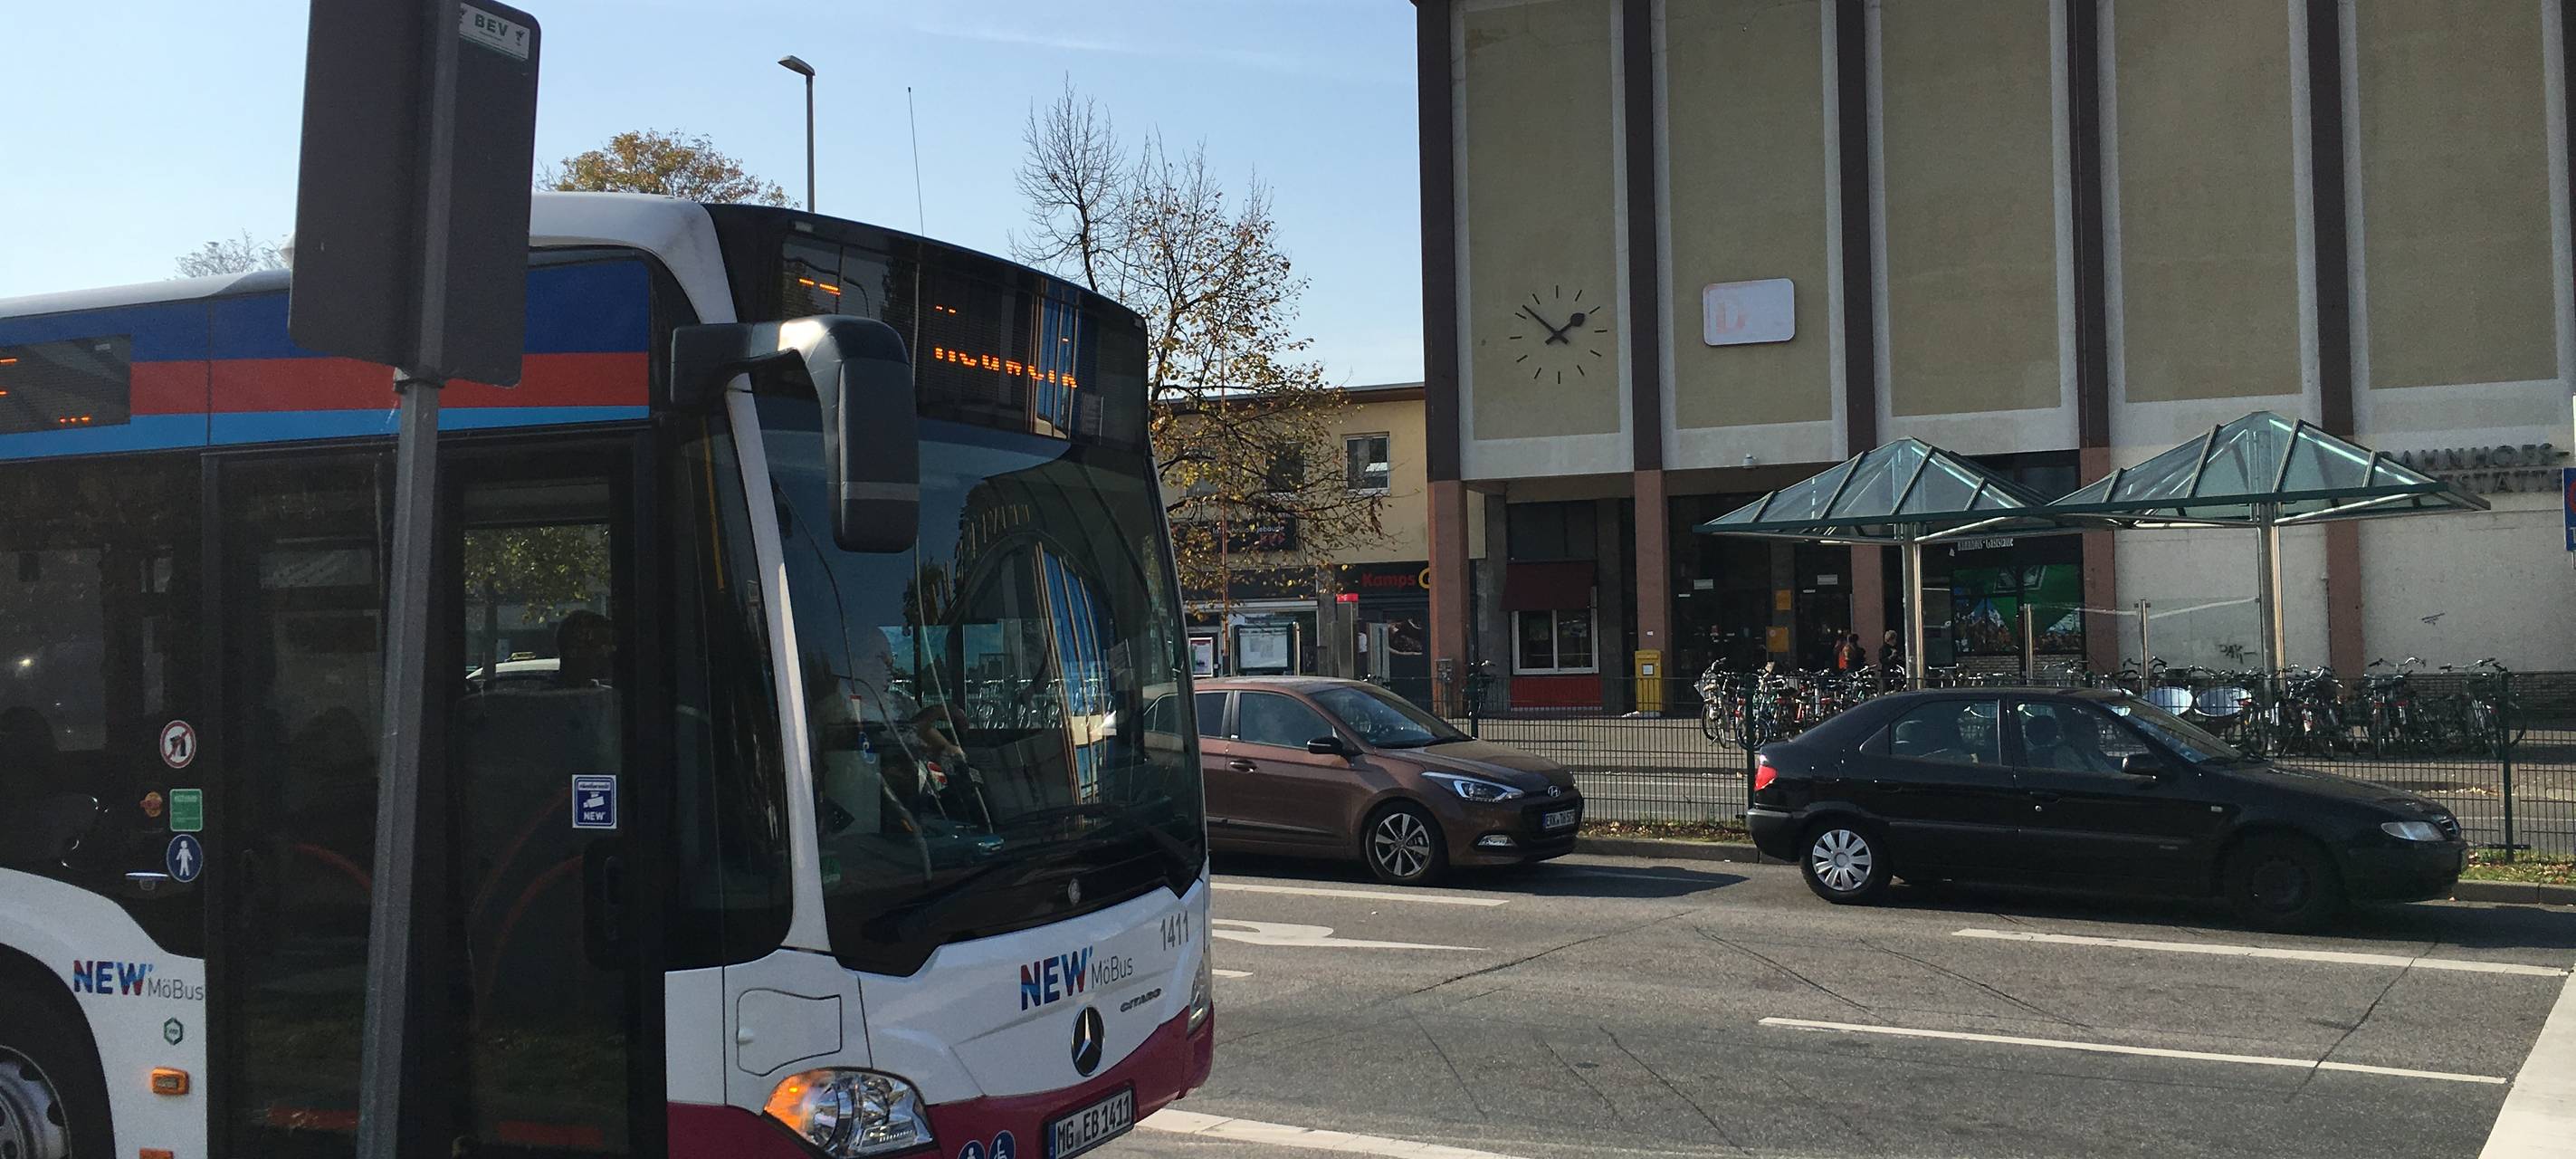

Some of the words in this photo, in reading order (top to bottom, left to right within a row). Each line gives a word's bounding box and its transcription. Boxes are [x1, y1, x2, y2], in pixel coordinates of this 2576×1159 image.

[474, 14, 508, 36] BEV
[1361, 572, 1416, 589] Kamps
[1160, 910, 1189, 951] 1411
[1091, 955, 1133, 989] MöBus
[148, 978, 204, 1001] MöBus
[1057, 1120, 1074, 1154] MG
[1083, 1109, 1099, 1142] EB
[1102, 1095, 1131, 1134] 1411
